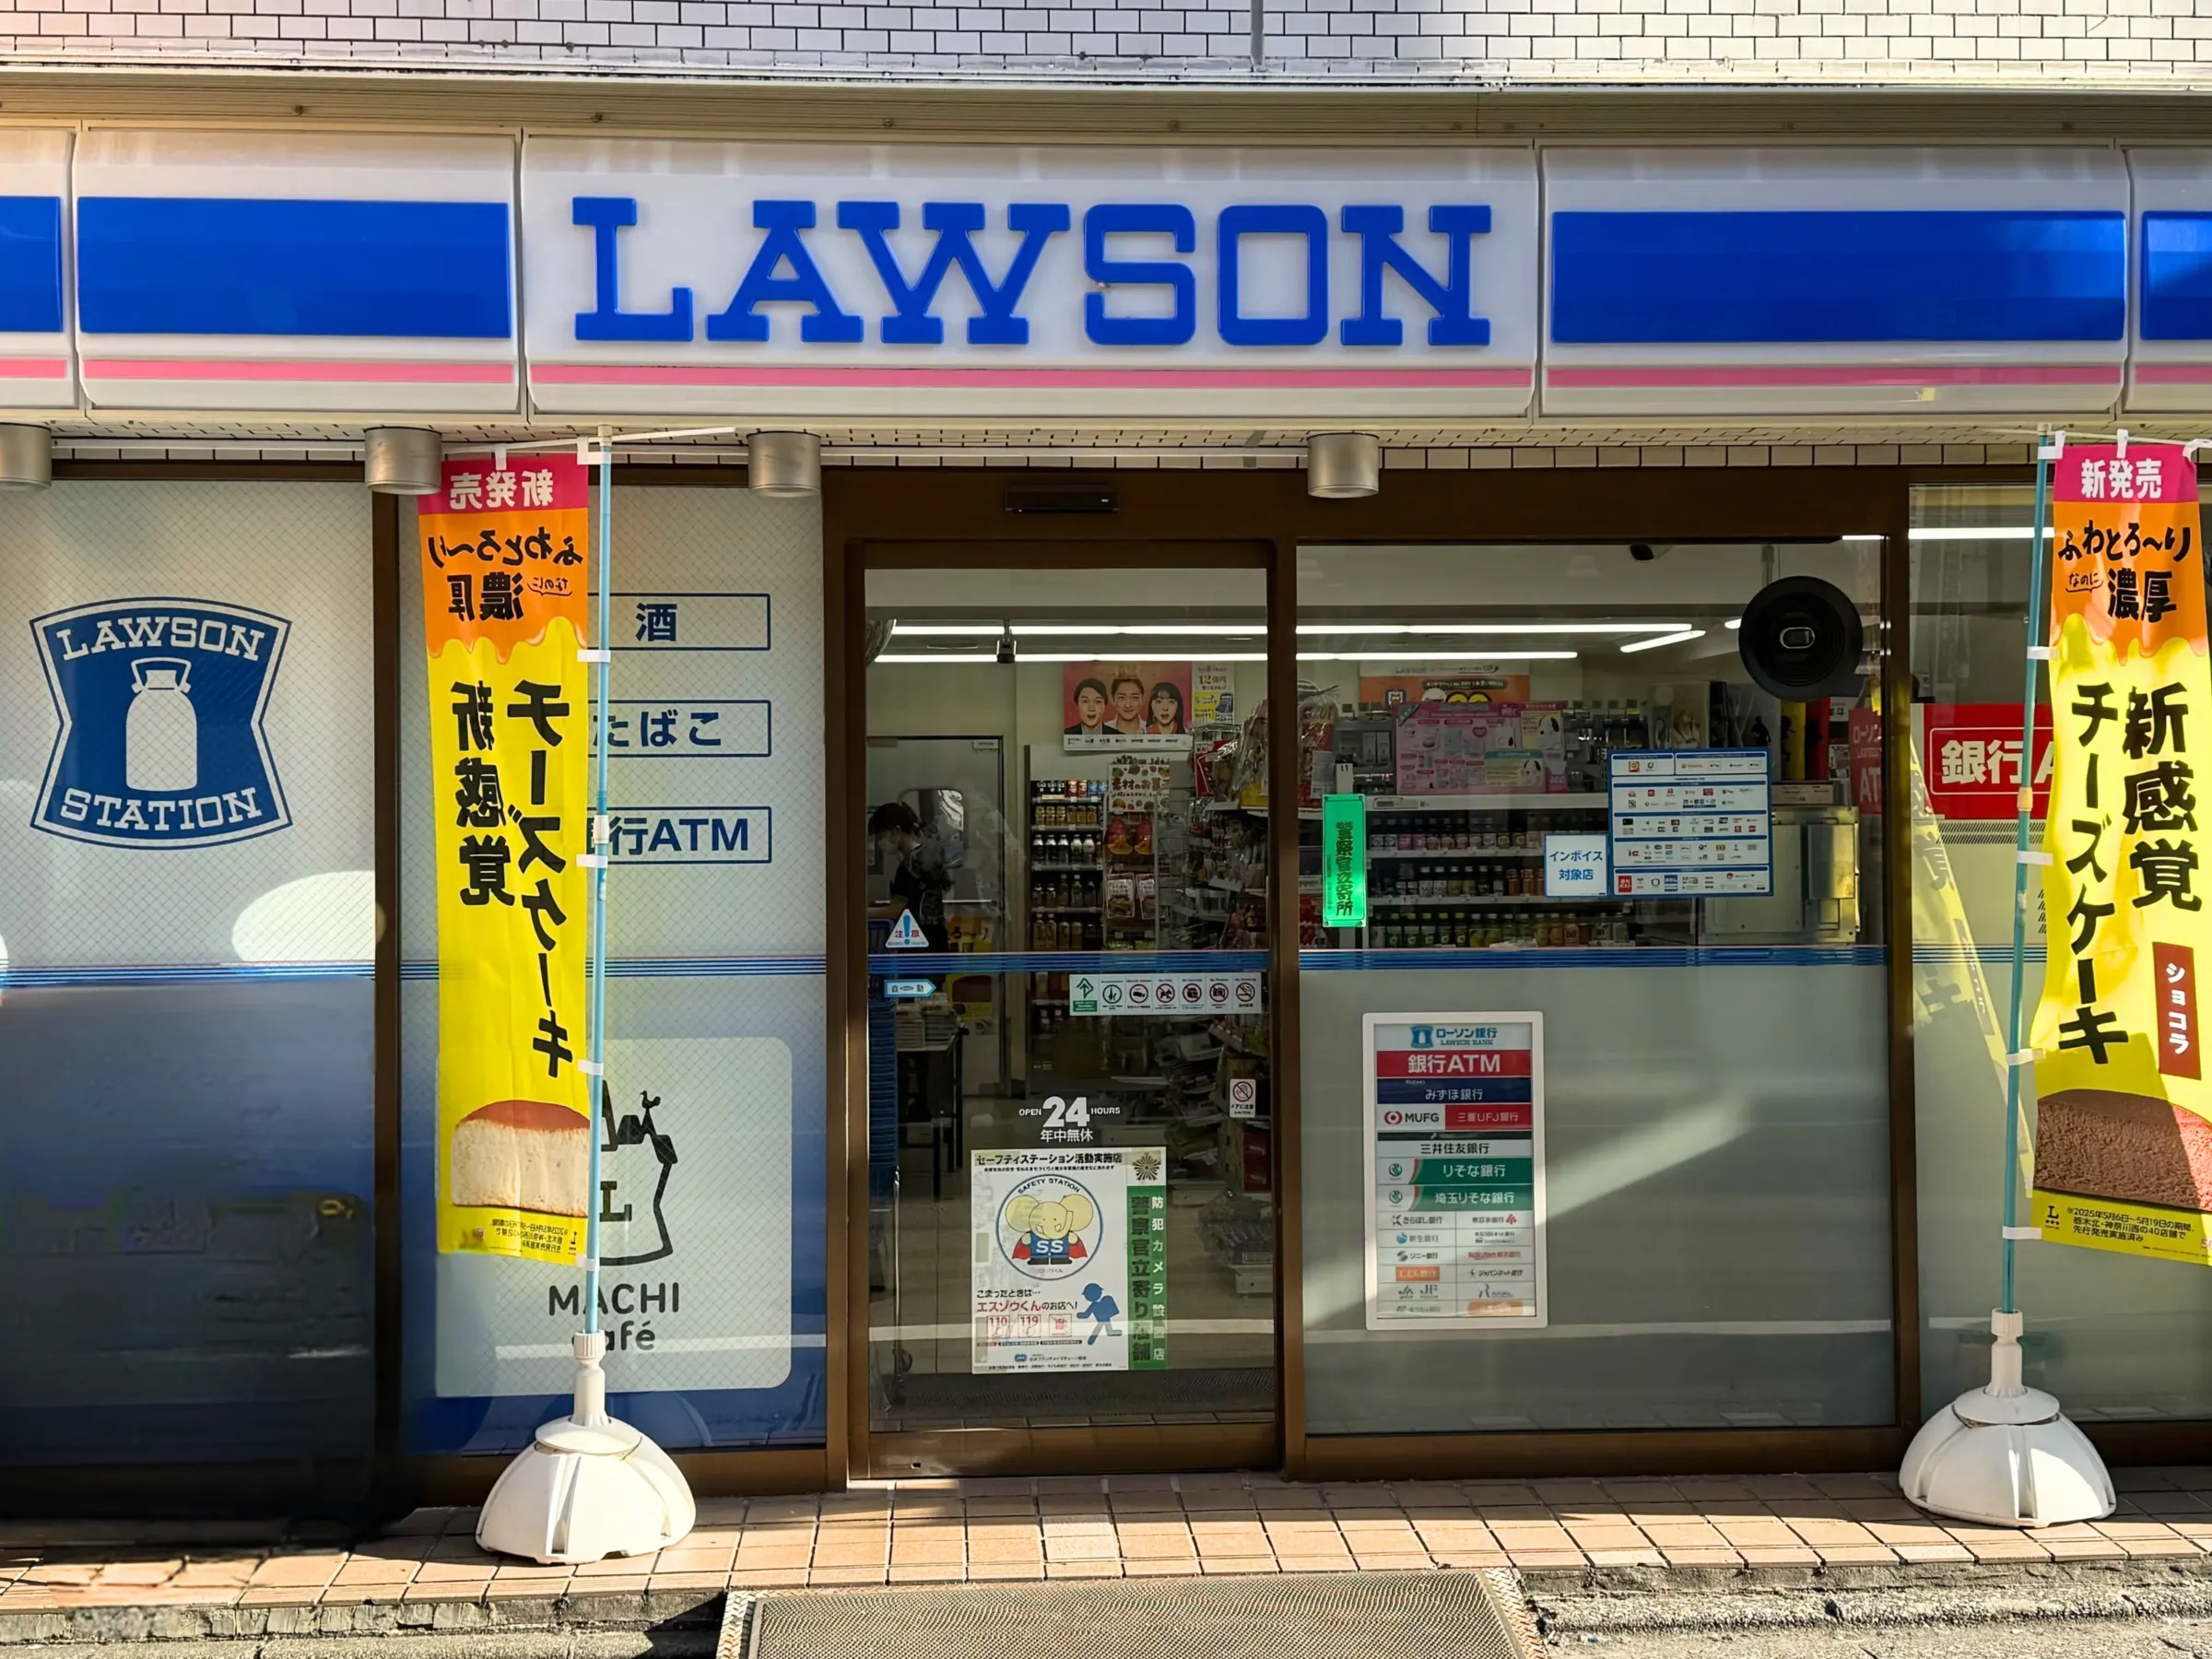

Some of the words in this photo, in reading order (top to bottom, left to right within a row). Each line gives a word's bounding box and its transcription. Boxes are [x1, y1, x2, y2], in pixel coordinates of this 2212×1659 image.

[572, 196, 1491, 346] LAWSON
[2081, 458, 2162, 499] 新発売
[2068, 571, 2100, 587] なのに
[2107, 567, 2177, 623] 濃厚
[635, 602, 678, 642] 酒
[56, 616, 265, 661] LAWSON
[593, 709, 722, 747] たばこ
[2122, 682, 2202, 912] 新感覚
[60, 787, 263, 830] STATION
[587, 815, 748, 856] 行ATM
[1549, 850, 1603, 862] インボイス
[1559, 868, 1594, 880] 対象店
[2057, 682, 2129, 1065] チーズケーキ
[2166, 962, 2190, 1055] ショコラ
[1436, 1027, 1498, 1039] ローソン銀行
[1407, 1053, 1500, 1074] 銀行ATM
[1425, 1088, 1483, 1100] みずほ銀行
[1018, 1108, 1041, 1116] OPEN
[1042, 1096, 1090, 1128] 24
[1091, 1106, 1121, 1114] HOURS
[1405, 1112, 1440, 1123] MUFG
[1457, 1112, 1519, 1123] 三菱UFJ銀行
[1041, 1128, 1094, 1143] 年中無休
[1420, 1142, 1490, 1155] 三井住友銀行
[976, 1152, 1123, 1166] セーフティステーション活動実施店
[1442, 1163, 1506, 1178] りそな銀行
[1018, 1178, 1046, 1194] SAFETY
[1048, 1178, 1080, 1193] STATION
[1435, 1192, 1514, 1205] 埼玉りそな銀行
[2047, 1205, 2060, 1219] L
[1403, 1216, 1442, 1225] きらぼし銀行
[1410, 1252, 1439, 1260] ソニー銀行
[989, 1316, 1007, 1327] 110
[1019, 1315, 1039, 1325] 119
[571, 1320, 656, 1351] afé
